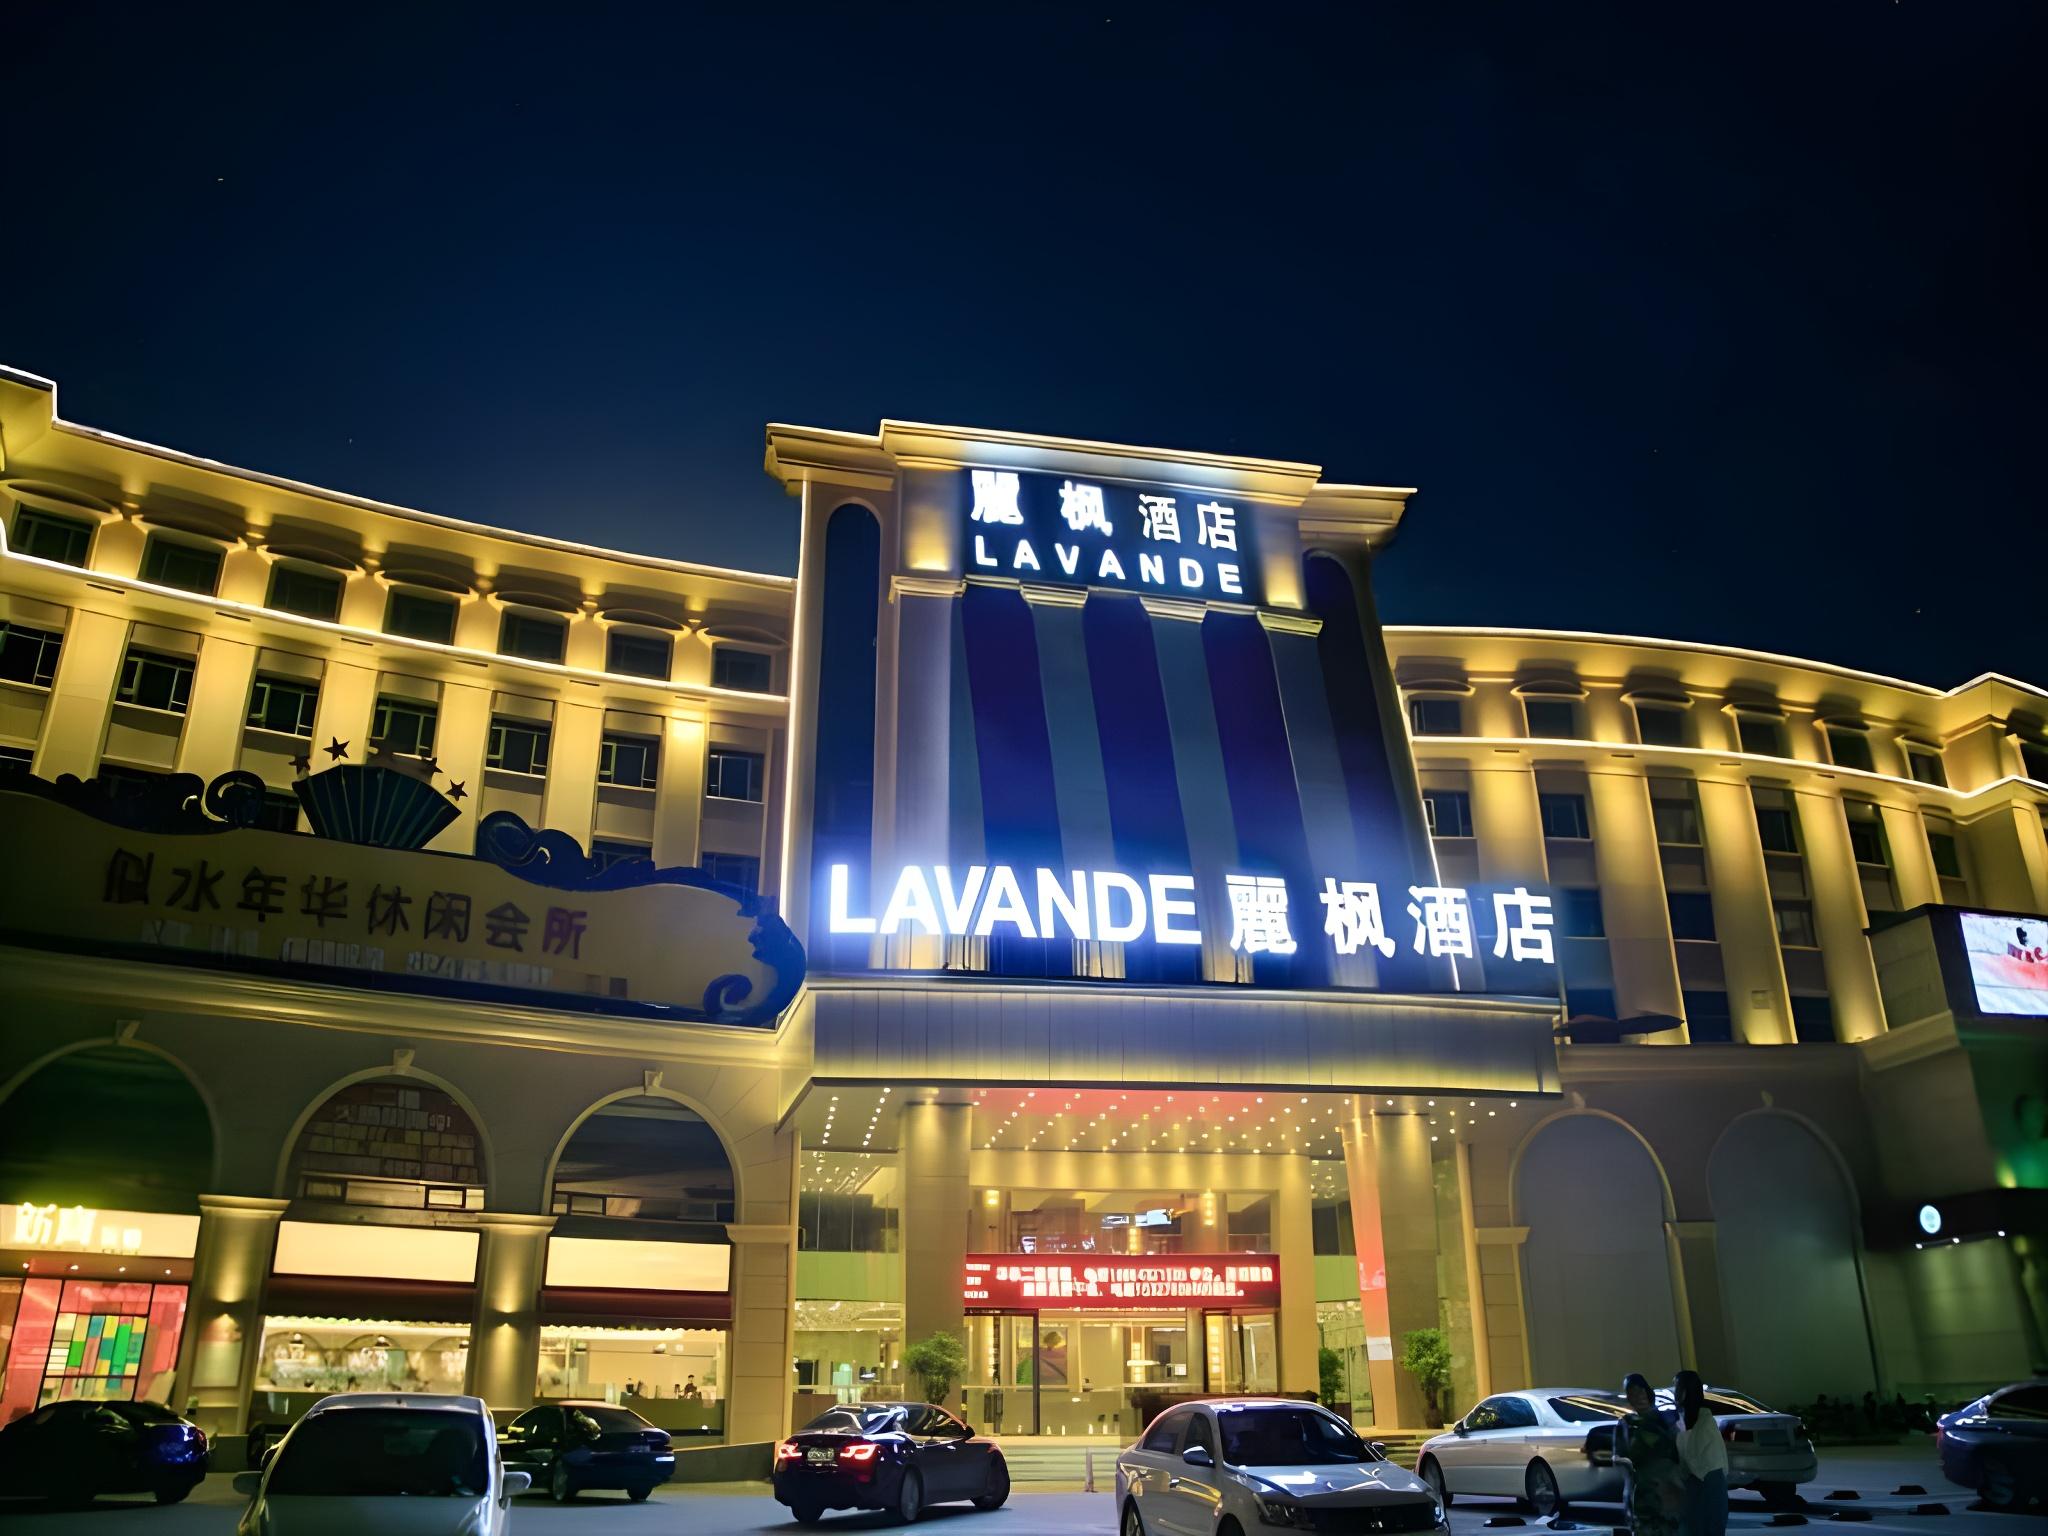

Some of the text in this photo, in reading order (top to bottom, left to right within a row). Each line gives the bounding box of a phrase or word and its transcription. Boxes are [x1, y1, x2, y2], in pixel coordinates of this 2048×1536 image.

[974, 535, 1244, 596] LAVANDE
[829, 863, 1557, 966] LAVANDE 麗枫酒店
